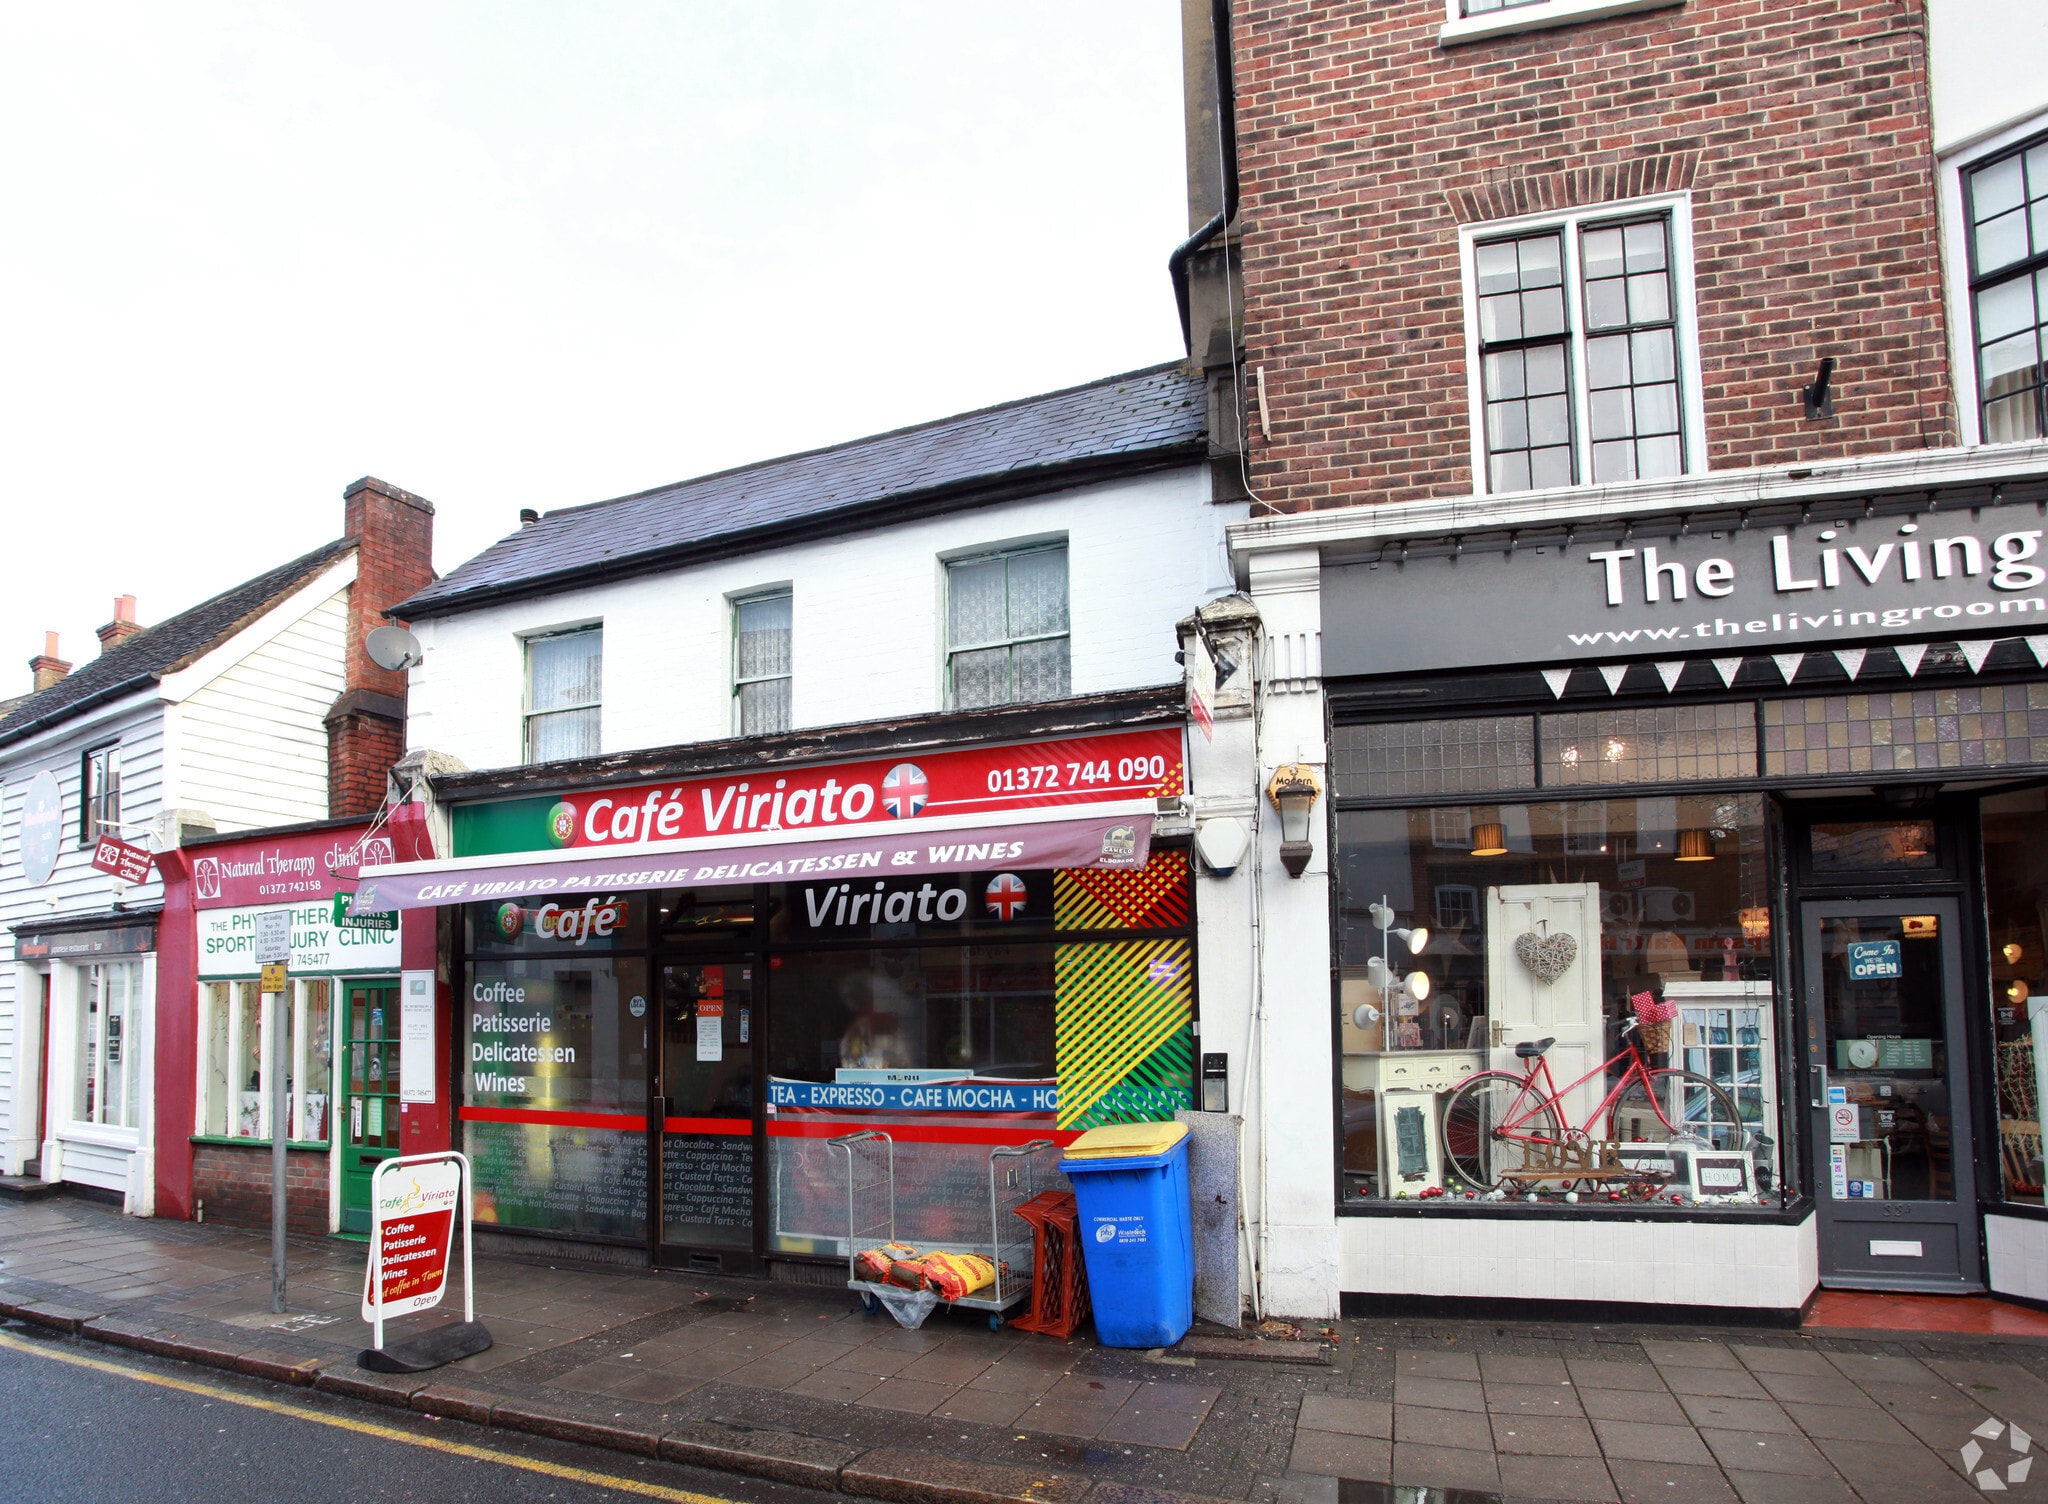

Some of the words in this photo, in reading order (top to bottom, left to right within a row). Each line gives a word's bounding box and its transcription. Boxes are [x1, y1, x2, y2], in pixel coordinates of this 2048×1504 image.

[1589, 546, 1736, 606] The
[1771, 523, 2047, 592] Living
[1567, 597, 2048, 647] www.thelivingroom
[987, 766, 1060, 793] 01372
[1066, 760, 1112, 787] 744
[1116, 755, 1167, 783] 090
[1275, 777, 1313, 785] Modern
[584, 788, 684, 843] Café
[122, 848, 151, 863] Natural
[221, 850, 265, 879] Natural
[267, 849, 315, 878] Therapy
[324, 842, 360, 869] Clinic
[120, 857, 147, 874] Therapy
[417, 881, 469, 901] CAFÉ
[471, 877, 558, 896] VIRIATO
[561, 868, 690, 888] PATISSERIE
[693, 851, 883, 881] DELICATESSEN
[890, 850, 918, 866] &
[927, 841, 1025, 864] WINES
[120, 869, 141, 881] Clinic
[259, 884, 286, 895] 01372
[288, 880, 322, 893] 742158
[535, 896, 616, 946] Café
[804, 881, 968, 928] Viriato
[211, 921, 228, 931] THE
[341, 917, 392, 929] INJURIES
[206, 934, 257, 954] SPORT
[289, 930, 329, 949] JURY
[339, 927, 395, 946] CLINIC
[297, 953, 331, 965] 745477
[1854, 946, 1879, 959] Come
[1855, 962, 1897, 976] OPEN
[473, 982, 525, 1003] Coffee
[699, 1004, 722, 1012] OPEN
[472, 1012, 551, 1033] Patisserie
[472, 1042, 576, 1063] Delicatessen
[474, 1072, 526, 1092] Wines
[770, 1086, 796, 1104] TEA
[811, 1087, 885, 1106] EXPRESSO
[900, 1088, 942, 1108] CAFE
[947, 1089, 1014, 1109] MOCHA
[673, 1139, 715, 1150] Chocolate
[685, 1151, 734, 1162] Cappuccino
[1522, 1139, 1623, 1171] LOVE
[700, 1162, 719, 1174] Cafe
[721, 1163, 751, 1173] Mocha
[679, 1171, 712, 1182] Custard
[714, 1173, 734, 1183] Tarts
[1704, 1172, 1740, 1183] HOME
[673, 1182, 715, 1193] Chocolate
[380, 1196, 403, 1210] Café
[421, 1189, 456, 1202] Viriato
[686, 1193, 734, 1205] Cappuccino
[700, 1204, 720, 1216] Cafe
[721, 1206, 751, 1217] Mocha
[680, 1213, 712, 1224] Custard
[714, 1215, 734, 1225] Tarts
[385, 1222, 415, 1236] Coffee
[1100, 1228, 1113, 1237] phs
[383, 1235, 427, 1250] Patisserie
[381, 1248, 437, 1266] Delicatessen
[381, 1268, 408, 1281] Wines
[390, 1278, 411, 1295] coffee
[412, 1277, 420, 1287] in
[421, 1269, 443, 1282] Town
[413, 1295, 438, 1307] Open
